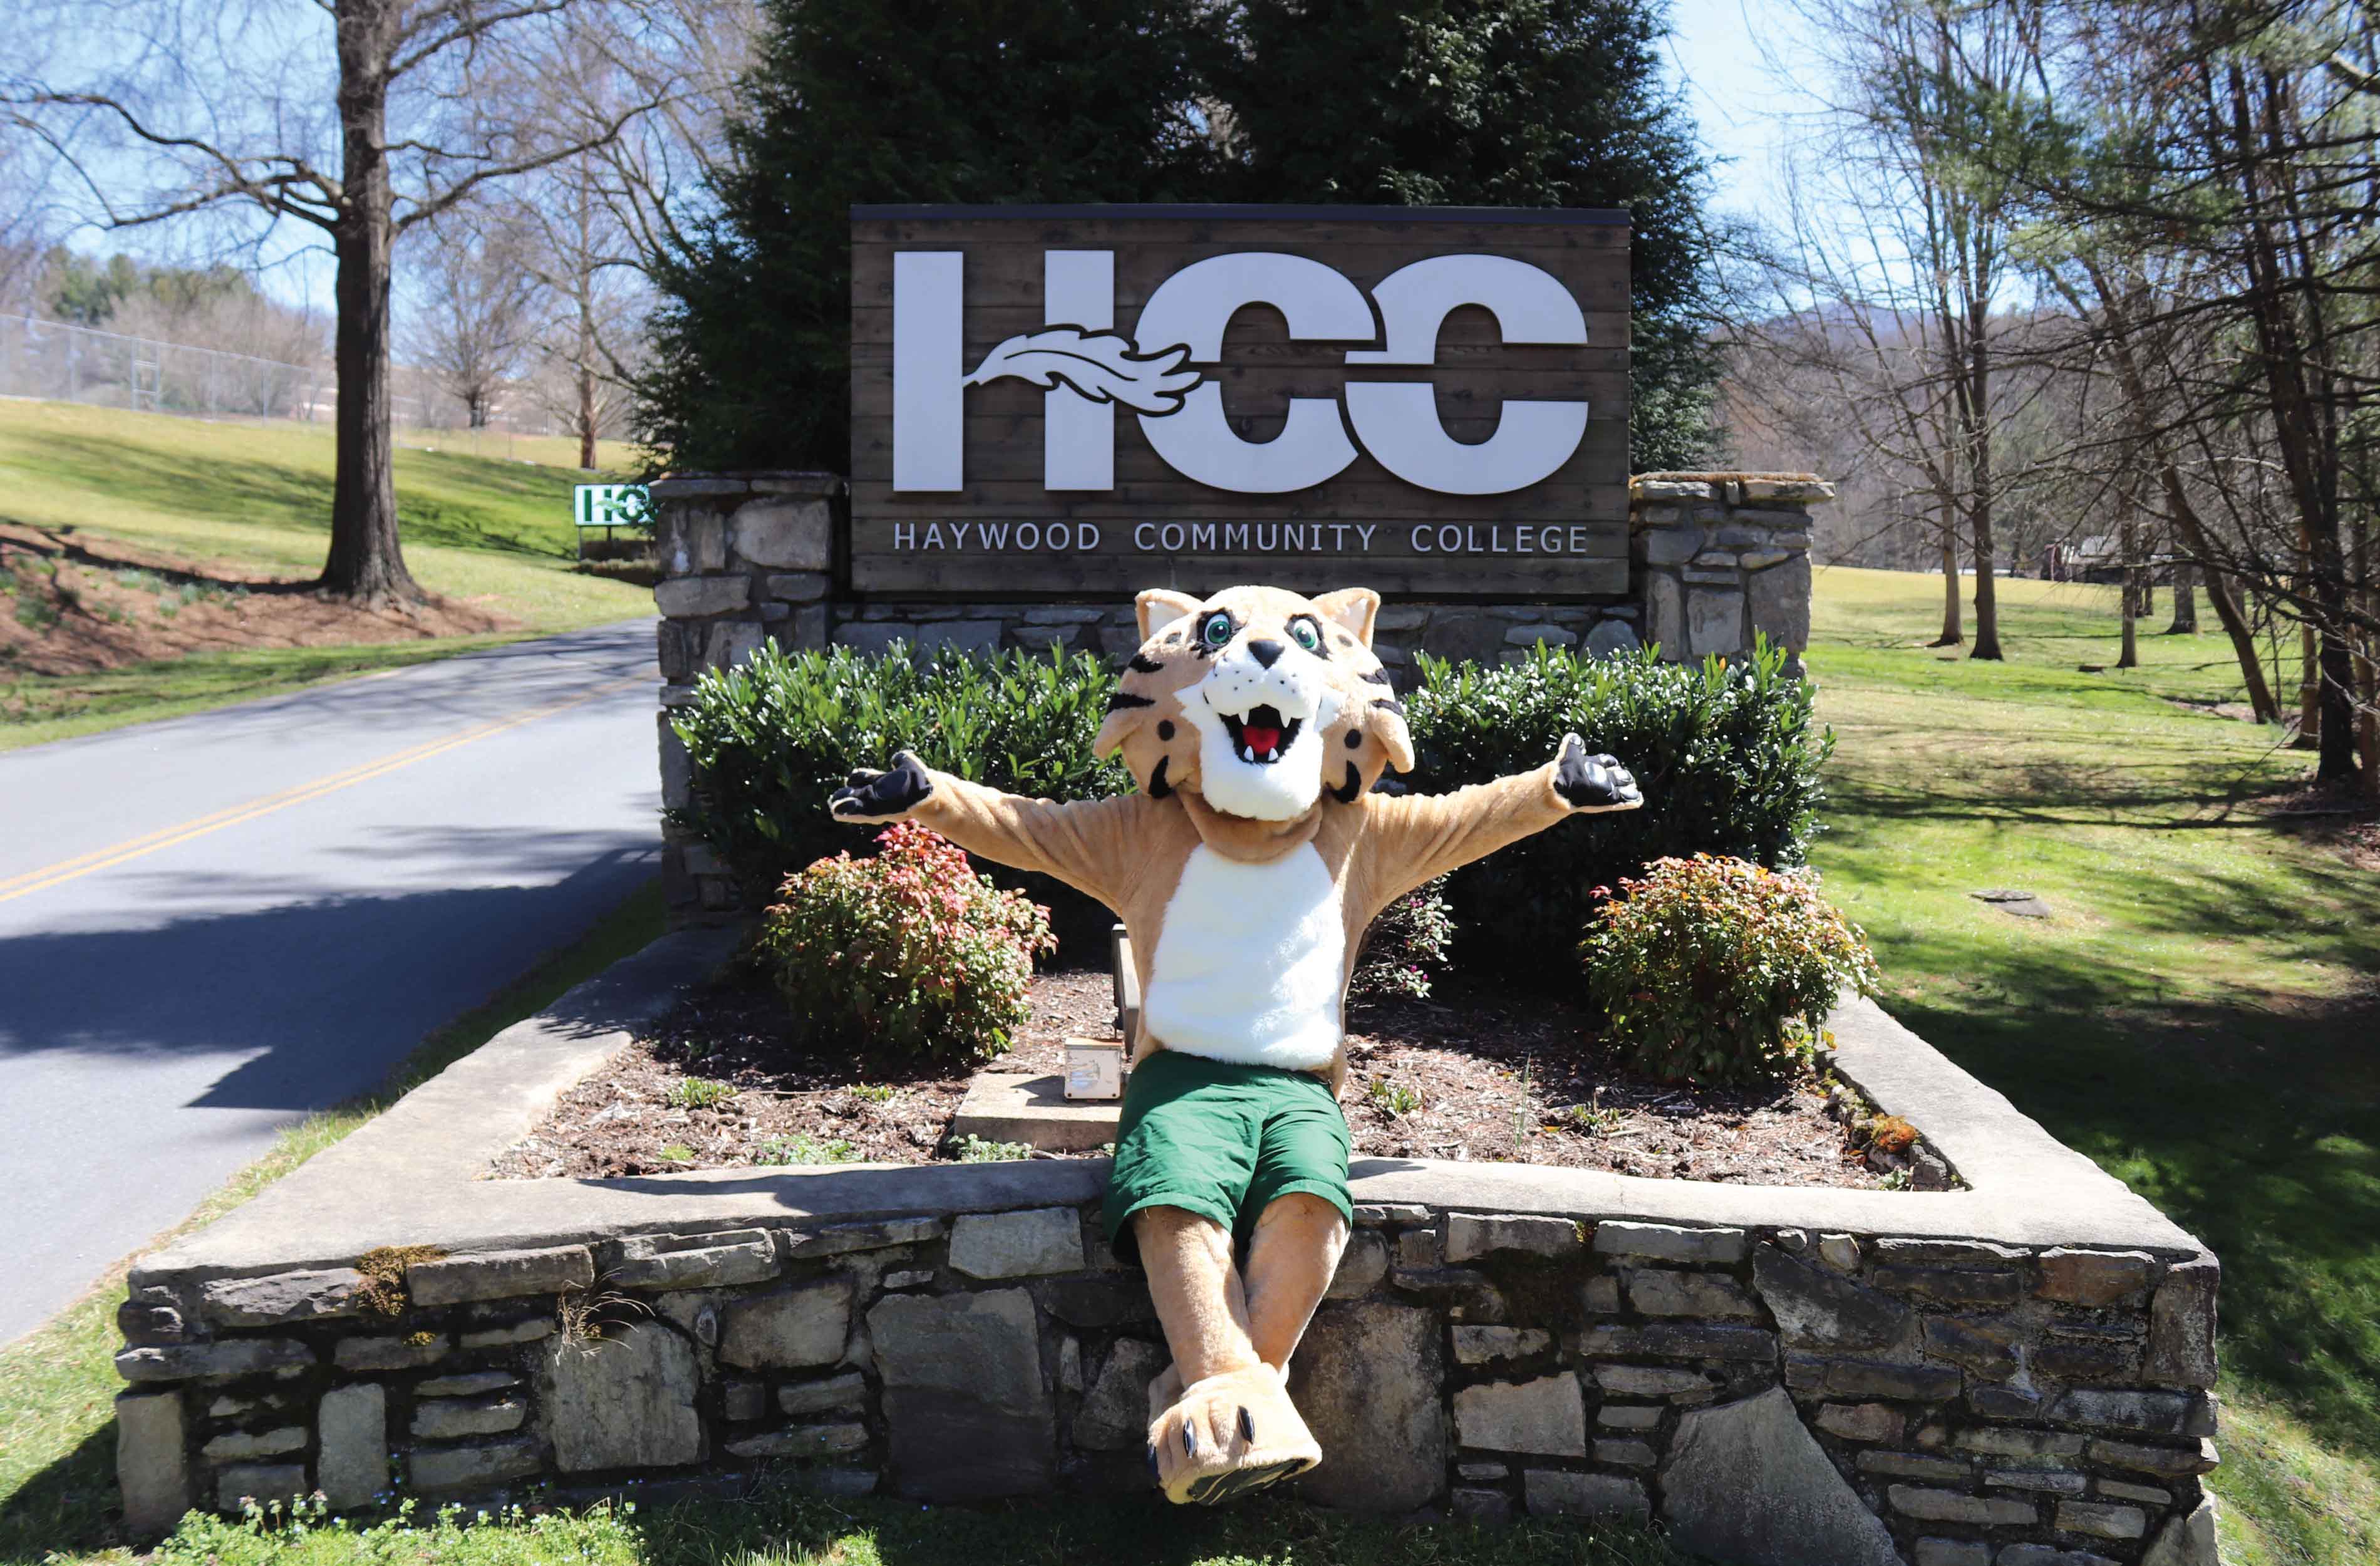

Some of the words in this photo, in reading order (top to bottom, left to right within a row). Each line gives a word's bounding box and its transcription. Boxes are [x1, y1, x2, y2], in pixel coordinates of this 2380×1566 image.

[893, 250, 1588, 495] HCC
[584, 489, 656, 522] HC
[894, 522, 1100, 551] HAYWOOD
[1134, 522, 1377, 551] COMMUNITY
[1410, 524, 1586, 553] COLLEGE
